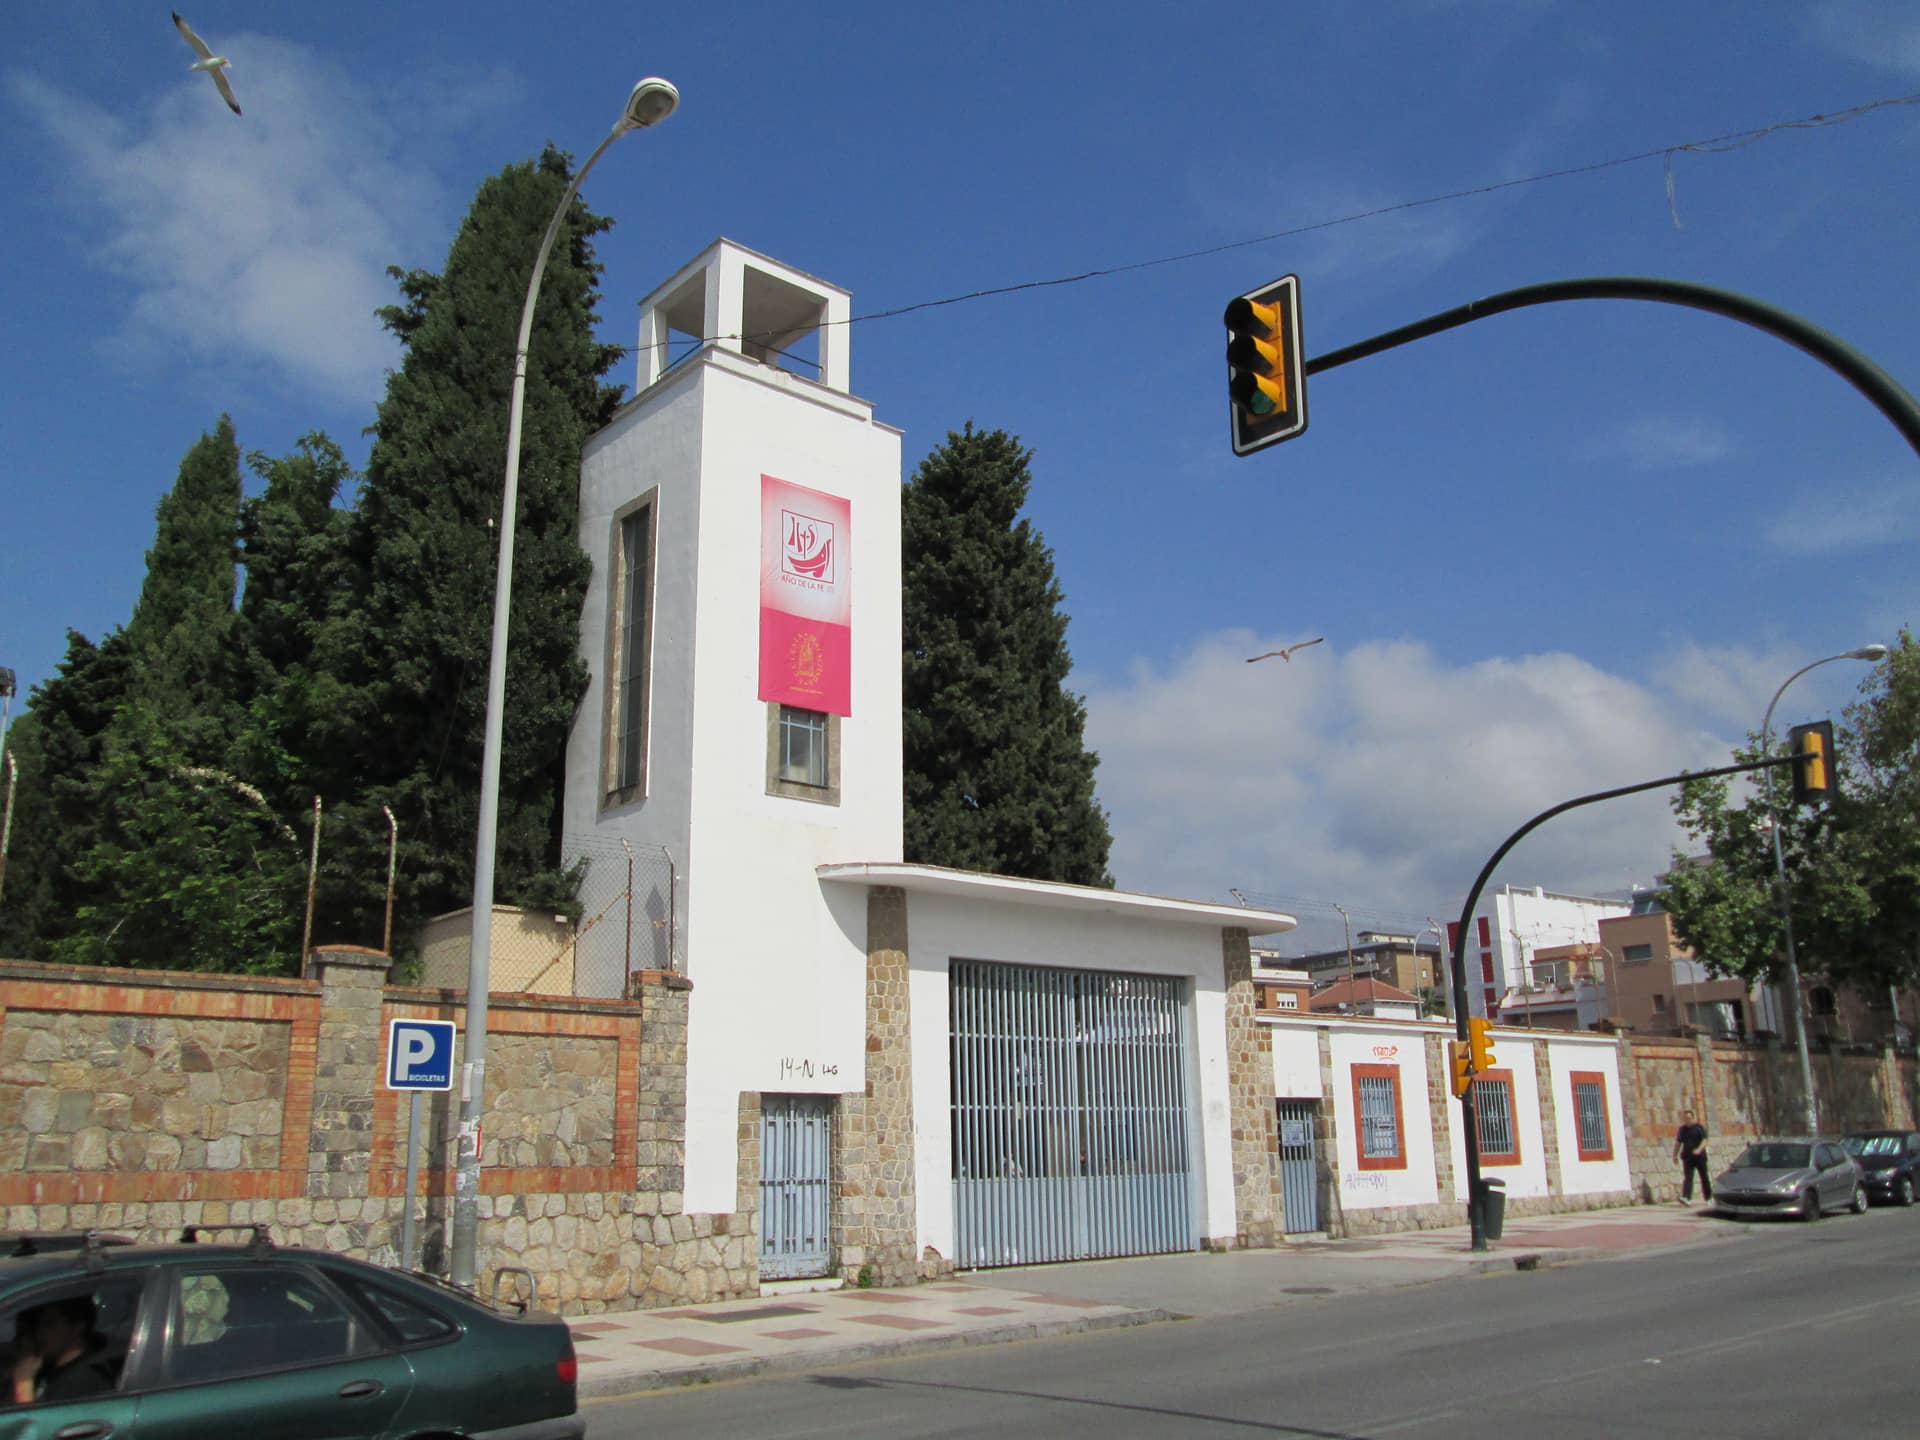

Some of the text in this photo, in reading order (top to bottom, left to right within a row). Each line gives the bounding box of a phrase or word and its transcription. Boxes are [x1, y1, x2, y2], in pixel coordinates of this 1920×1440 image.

[798, 579, 807, 588] DE
[807, 582, 816, 590] LA
[817, 584, 825, 592] FE
[395, 1028, 435, 1081] P
[409, 1074, 446, 1082] BICICLETAS
